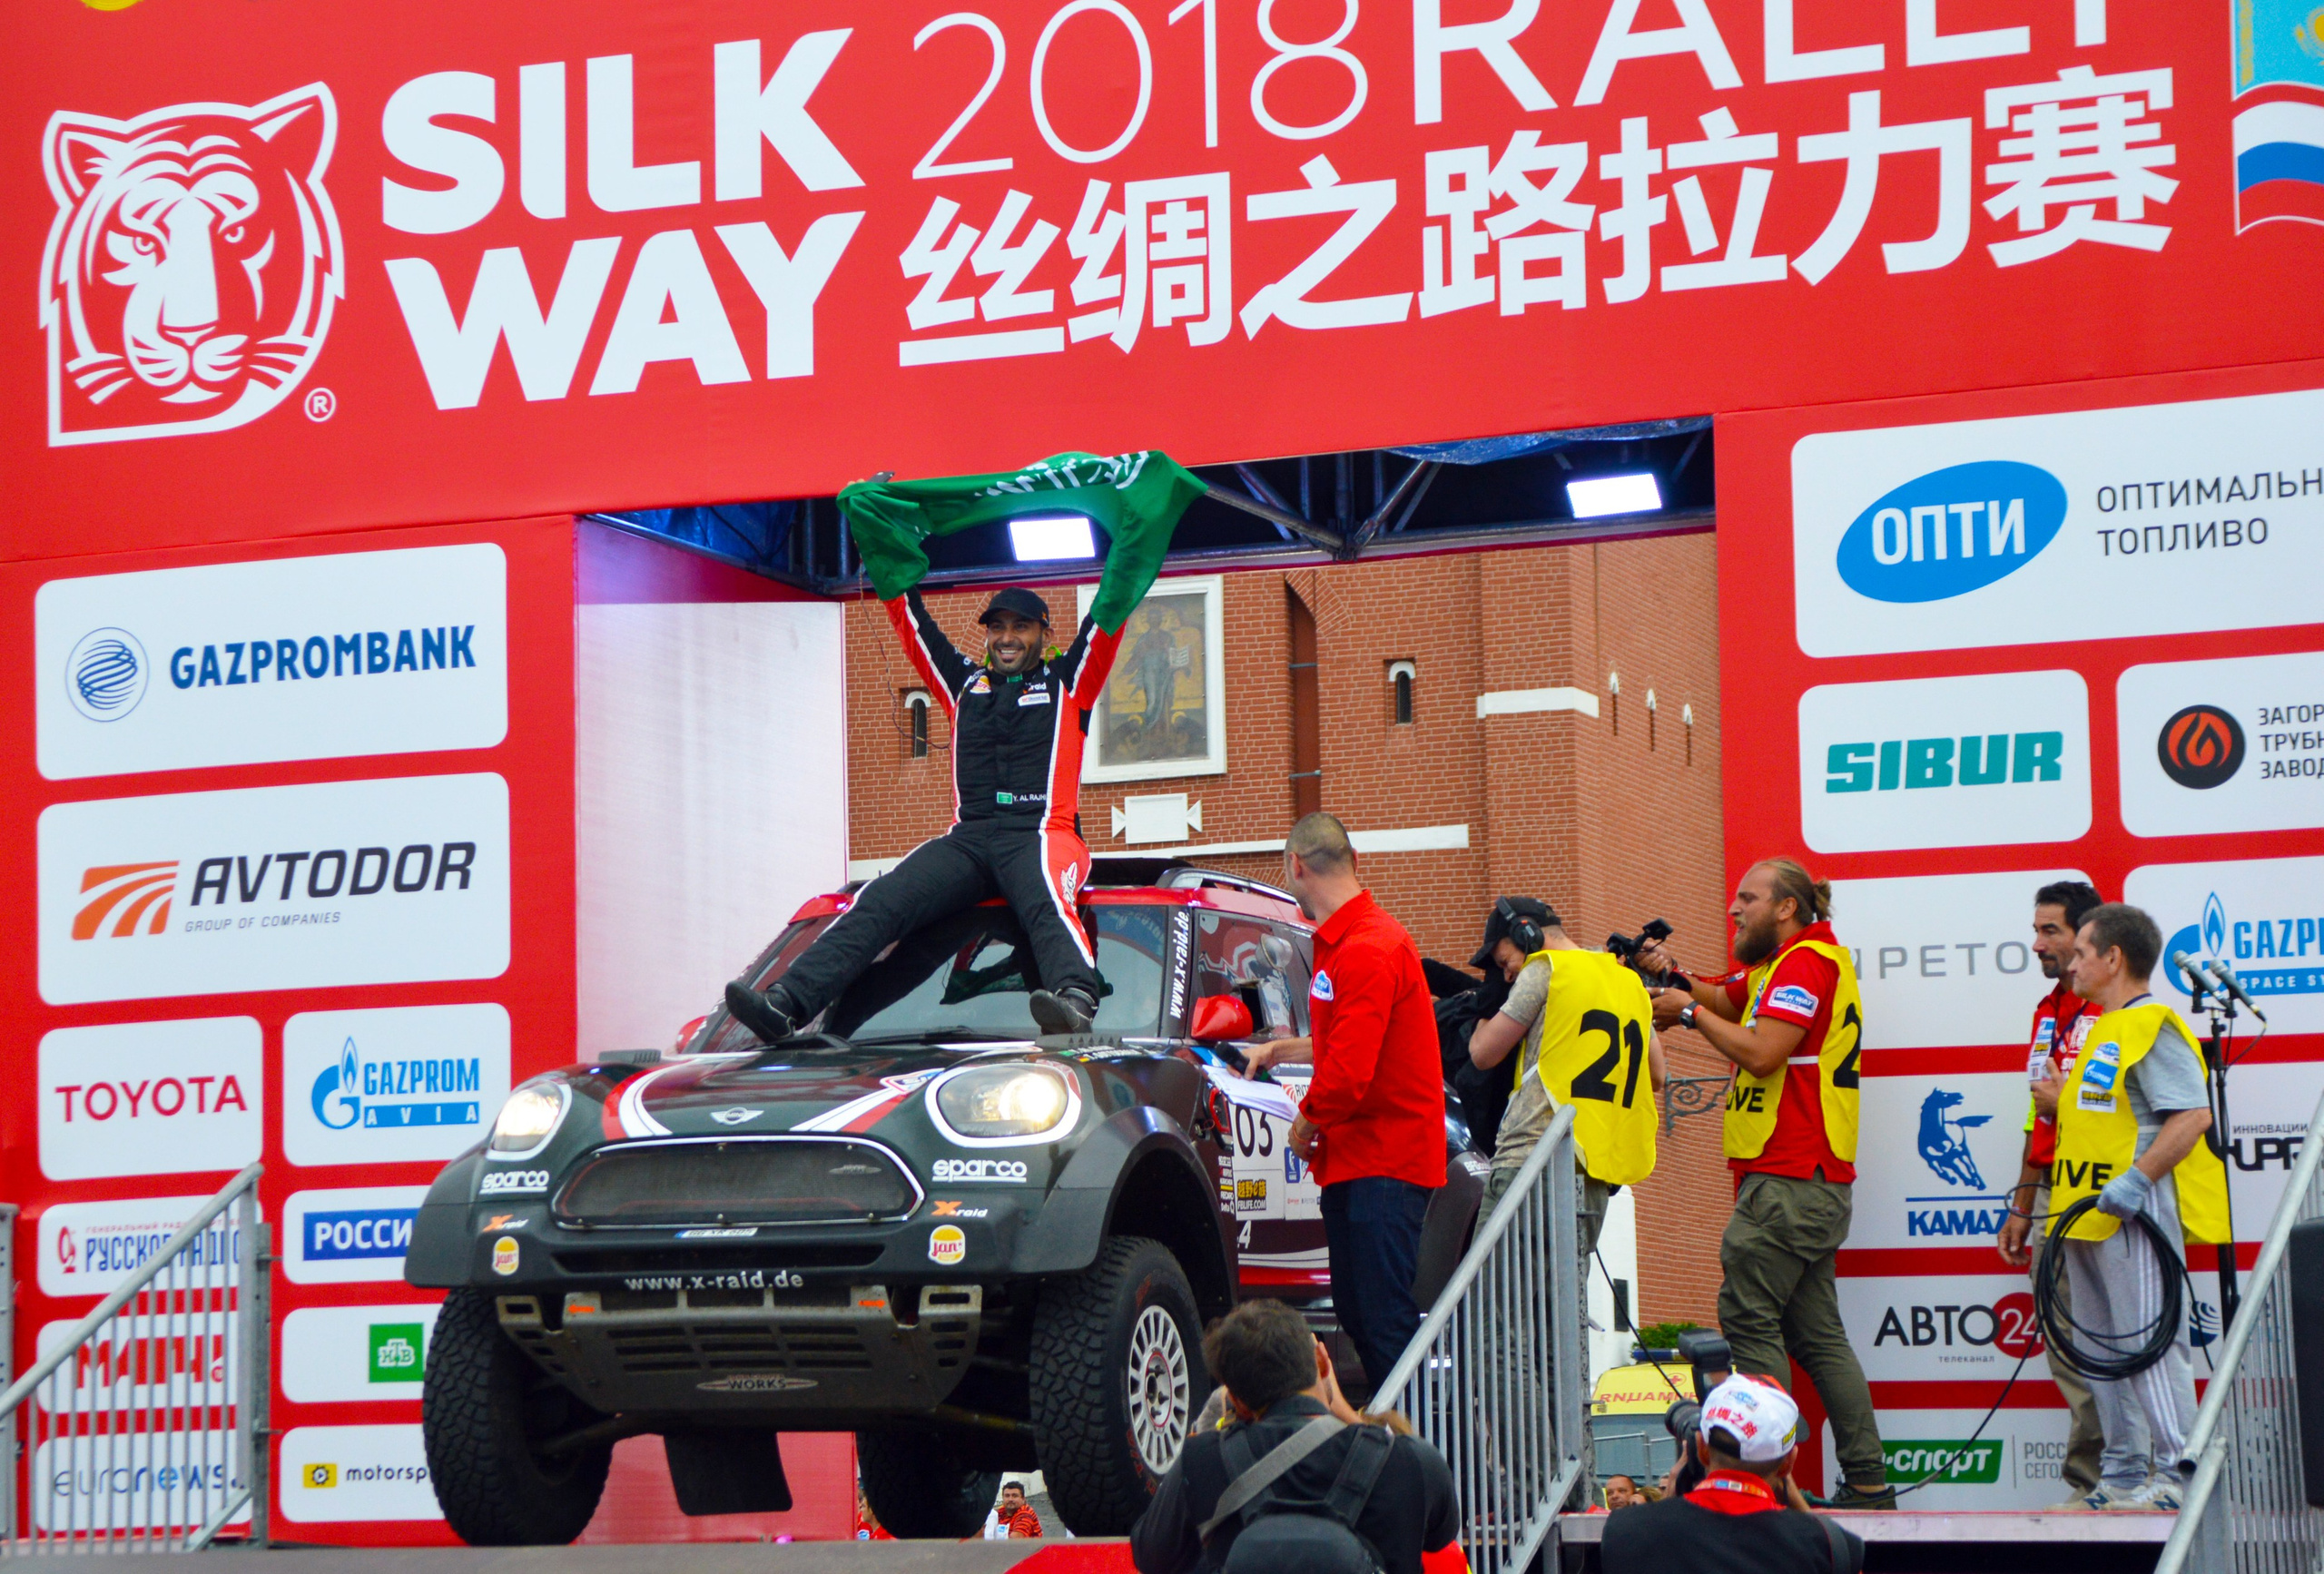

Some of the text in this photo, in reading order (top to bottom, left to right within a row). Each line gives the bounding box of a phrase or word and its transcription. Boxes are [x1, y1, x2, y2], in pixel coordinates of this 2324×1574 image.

[382, 27, 866, 234] SILK
[912, 0, 1368, 180] 2018
[900, 65, 2180, 367] 丝绸之路拉力赛
[384, 211, 866, 411] WAY
[2096, 467, 2324, 513] ОПТИМАЛЬН
[1871, 497, 2026, 566] ОПТИ
[2096, 517, 2270, 556] ТОПЛИВО
[170, 625, 477, 690] GAZPROMBANK
[2258, 703, 2324, 725] ЗАГОР
[1826, 731, 2063, 794] SIBUR
[190, 841, 477, 906] AVTODOR
[185, 911, 341, 933] GROUP OF COMPANIES
[1169, 910, 1190, 1019] www.x-raid.de
[2240, 975, 2297, 989] SPACE
[1571, 1008, 1645, 1110] 21
[364, 1058, 480, 1097] GAZPROM
[55, 1075, 248, 1123] TOYOTA
[366, 1106, 478, 1126] AVIA
[2233, 1123, 2309, 1135] ИННОВАЦИИ
[479, 1170, 550, 1195] sparco
[931, 1159, 1028, 1182] sparco
[314, 1218, 413, 1250] РОССИ
[1908, 1209, 2010, 1236] KAMAZ
[624, 1270, 804, 1291] www.x-raid.de
[1938, 1355, 1995, 1363] телеканал
[727, 1378, 787, 1390] WORKS
[1882, 1449, 1993, 1479] -спорт
[2024, 1441, 2070, 1460] РОСС
[346, 1464, 428, 1483] motorsp
